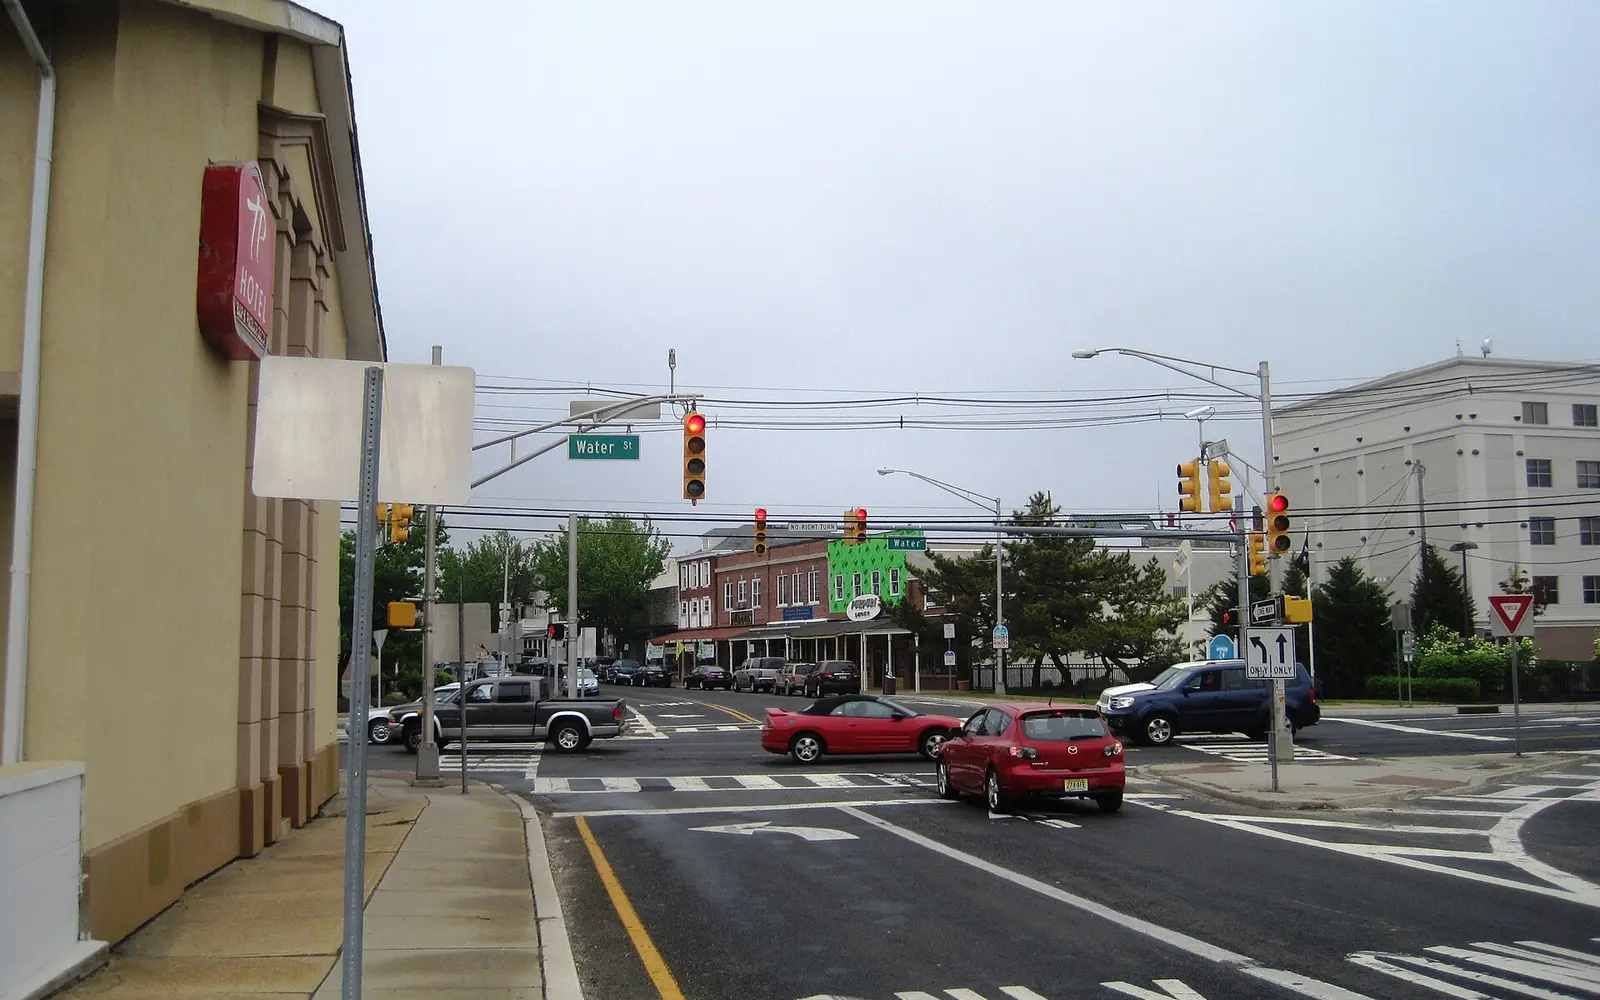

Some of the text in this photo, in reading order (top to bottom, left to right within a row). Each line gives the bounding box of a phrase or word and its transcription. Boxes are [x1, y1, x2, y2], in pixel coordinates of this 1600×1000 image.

[239, 265, 267, 324] HOTEL
[576, 440, 632, 454] Water St
[893, 539, 920, 548] Water
[1256, 605, 1273, 616] ONE WAY
[1250, 666, 1292, 675] ONLY ONLY
